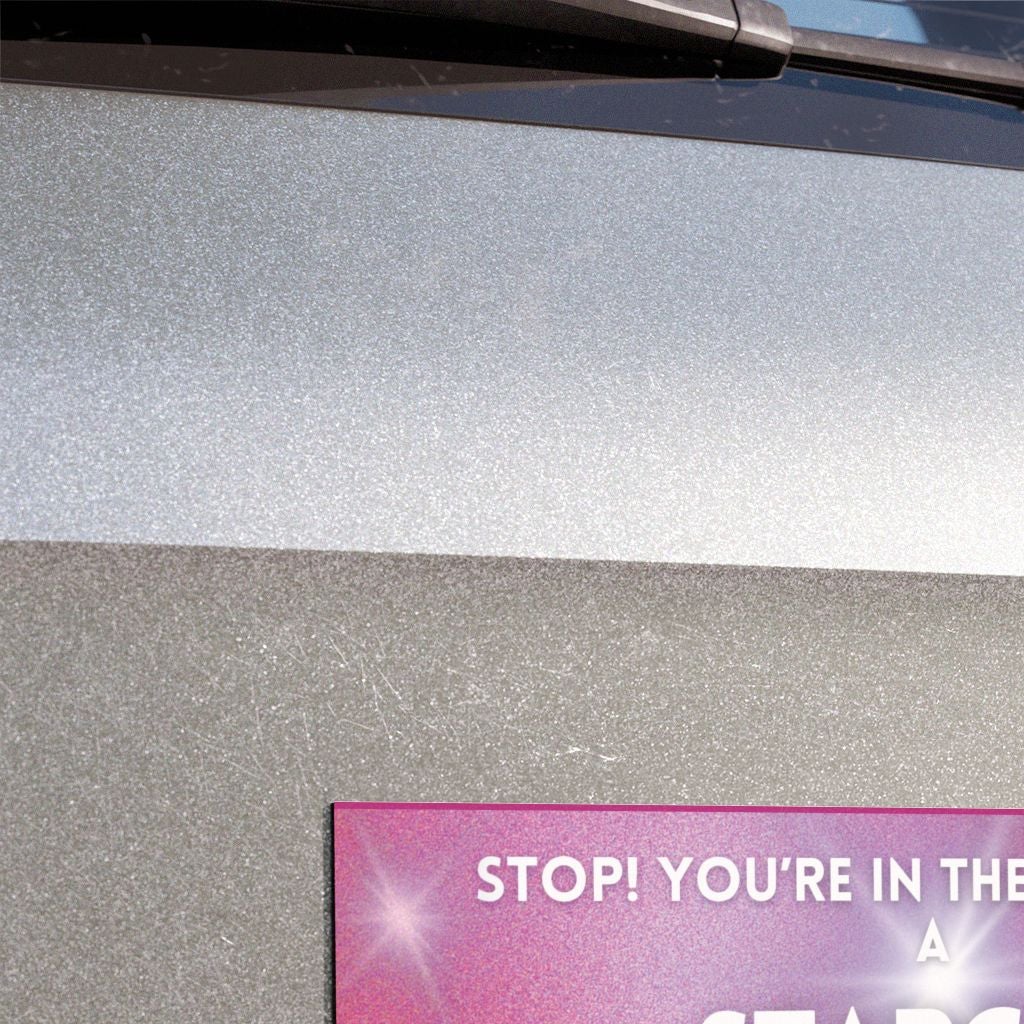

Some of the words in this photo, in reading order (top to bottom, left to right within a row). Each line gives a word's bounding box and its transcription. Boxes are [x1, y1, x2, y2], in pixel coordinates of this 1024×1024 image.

[476, 855, 639, 903] STOP!
[657, 855, 853, 903] YOU'RE
[872, 856, 922, 903] IN
[916, 917, 950, 964] A
